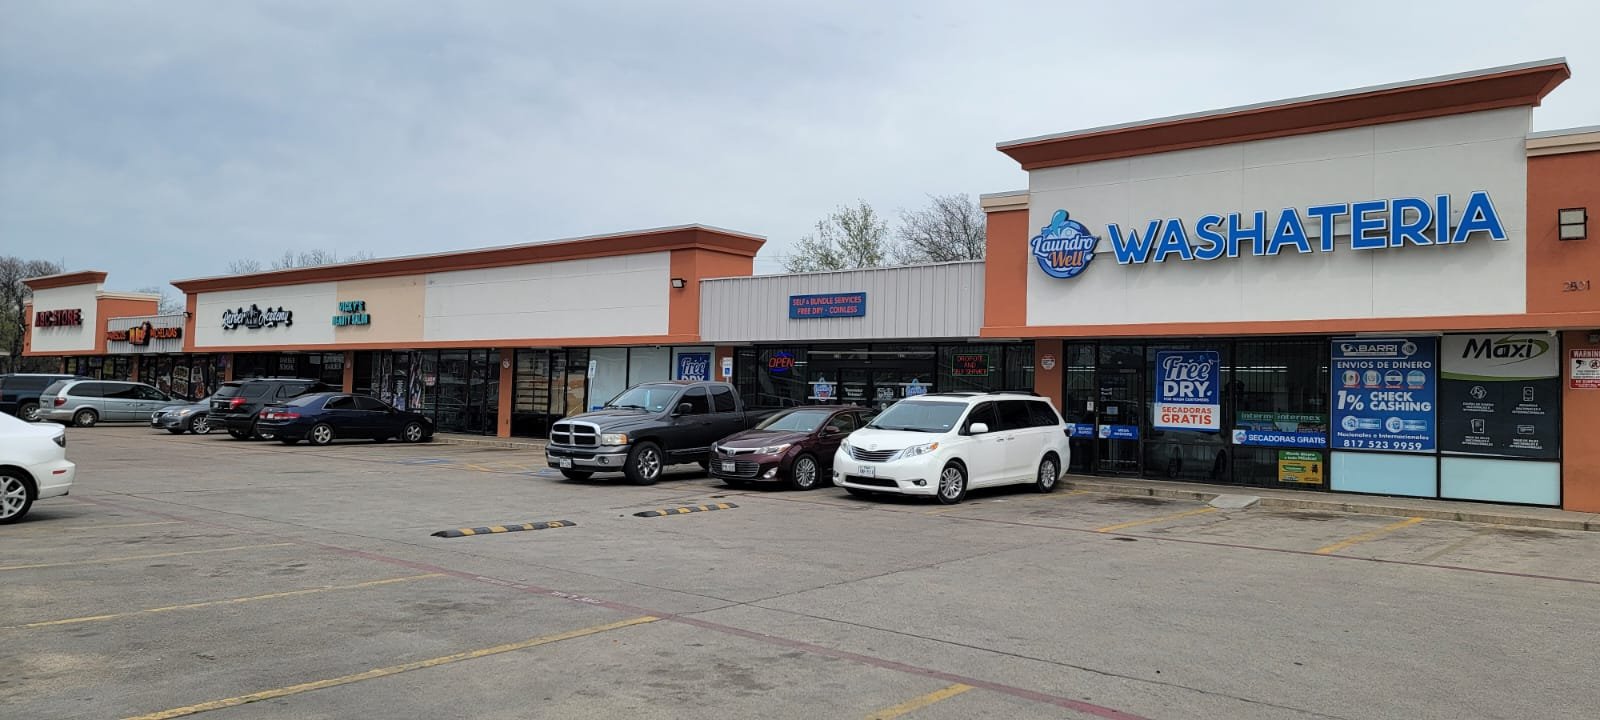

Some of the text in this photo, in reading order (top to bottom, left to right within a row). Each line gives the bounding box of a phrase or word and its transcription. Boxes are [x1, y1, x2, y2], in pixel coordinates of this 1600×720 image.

[1106, 191, 1508, 265] WASHATERIA
[1031, 234, 1095, 257] Laundro
[1049, 250, 1083, 268] Well
[834, 296, 862, 304] SERVICES
[812, 307, 824, 315] DRY
[829, 306, 858, 314] COINLESS
[53, 309, 82, 326] STORE
[259, 310, 289, 327] Academy
[1358, 344, 1398, 352] BARRI
[1462, 338, 1534, 359] Maxi
[1573, 350, 1600, 358] WARNIN
[681, 358, 707, 375] Free
[768, 357, 795, 368] OPEN
[1337, 361, 1432, 369] ENVIOS DE DINERO
[1163, 356, 1211, 381] Free
[1163, 381, 1210, 397] DRY
[1337, 390, 1365, 411] 1%
[1370, 391, 1413, 401] CHECK
[1369, 401, 1432, 412] CASHING
[1162, 414, 1211, 425] GRATIS
[1241, 411, 1273, 419] interm
[1248, 434, 1326, 444] SECADORAS GRATIS
[1379, 432, 1430, 441] Internacionales
[1368, 441, 1389, 449] 523
[1393, 441, 1422, 450] 9959
